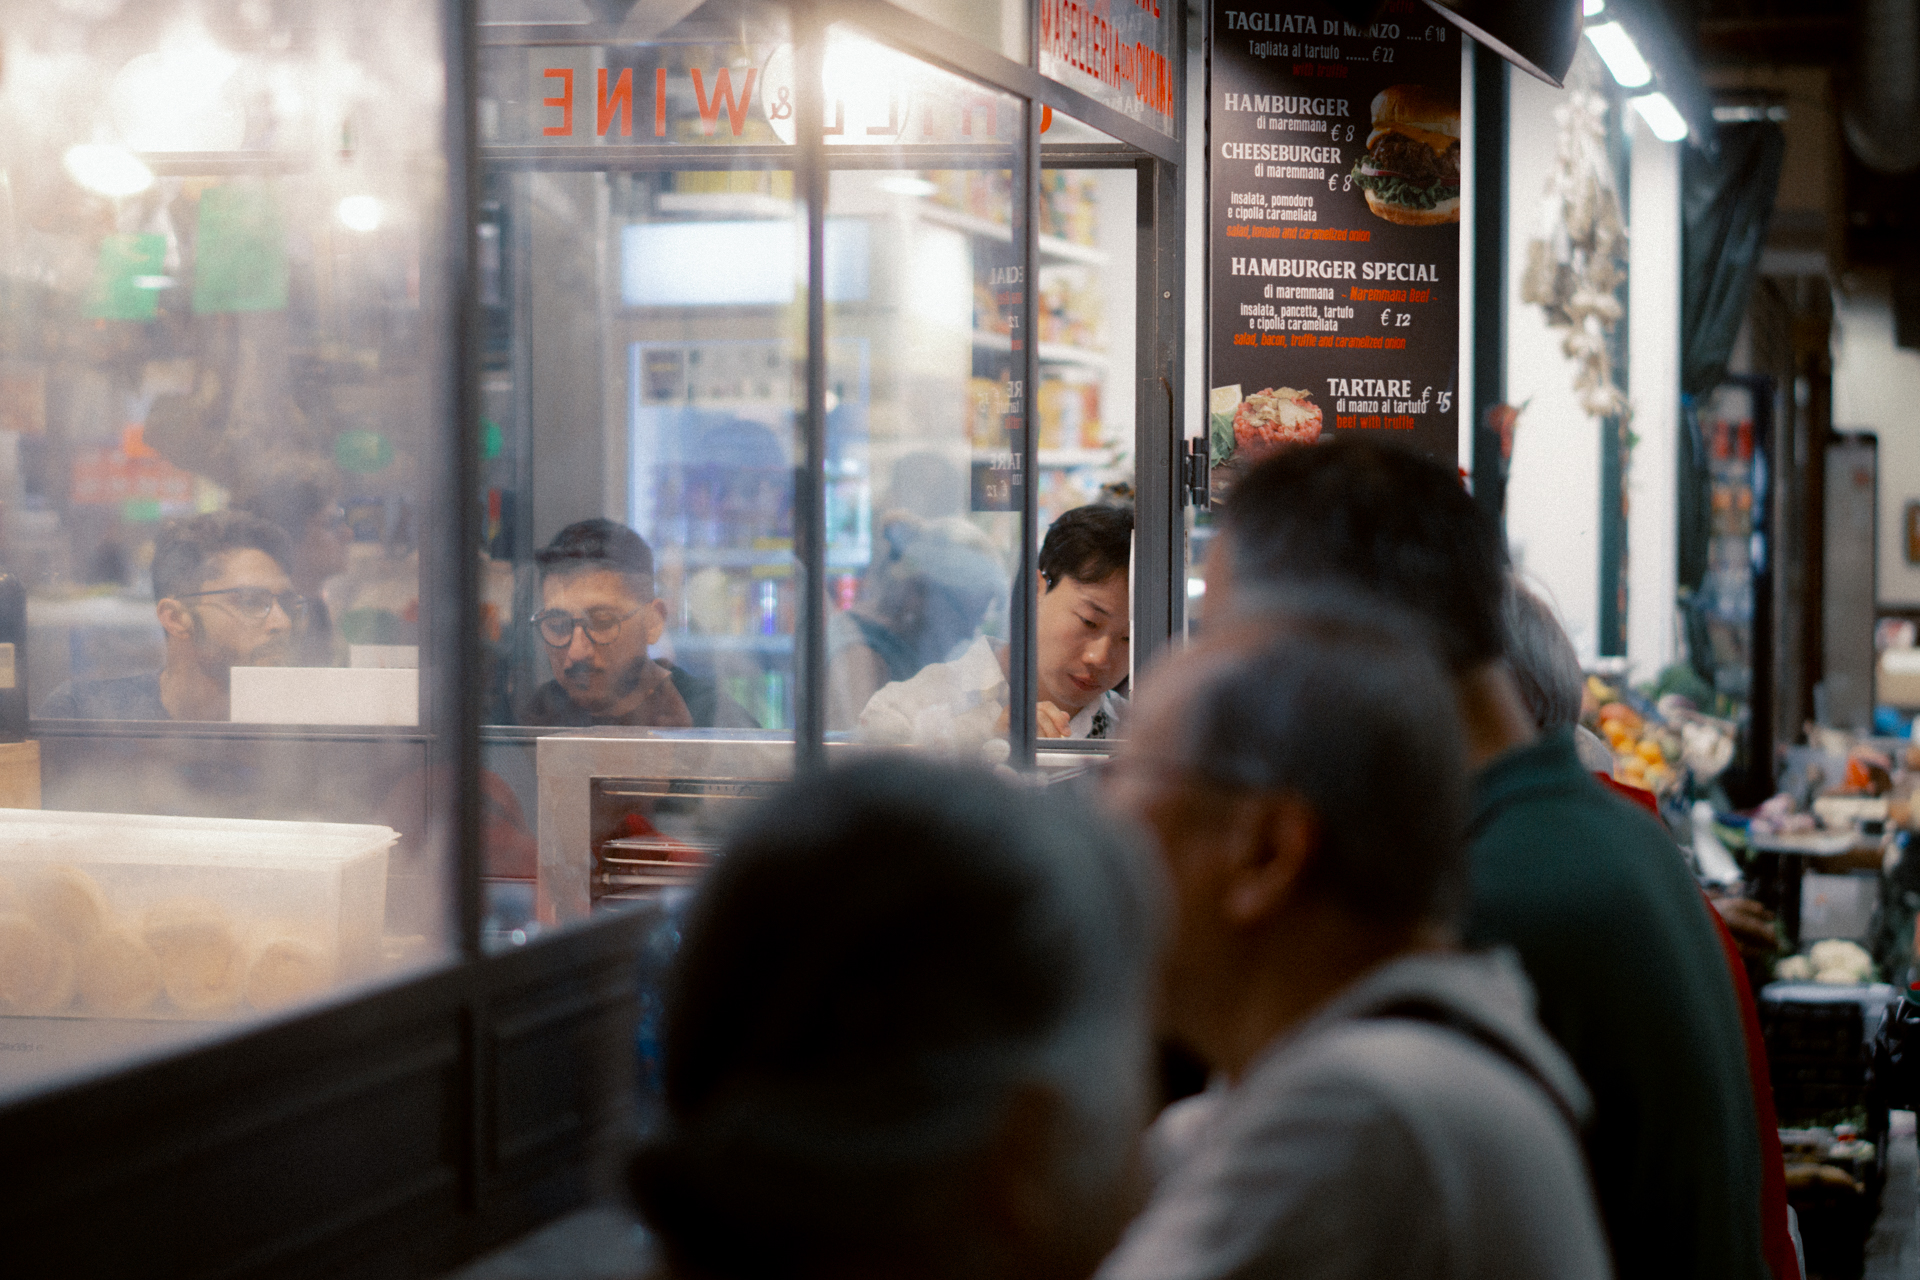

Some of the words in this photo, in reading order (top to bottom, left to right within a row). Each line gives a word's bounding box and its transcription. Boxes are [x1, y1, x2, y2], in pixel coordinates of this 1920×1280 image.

[1225, 11, 1317, 35] TAGLIATA
[1323, 20, 1339, 36] DI
[1343, 22, 1400, 39] MNZO
[1249, 40, 1289, 60] Tagliata
[1292, 41, 1301, 58] al
[1304, 42, 1340, 60] tartufo
[1224, 93, 1350, 117] HAMBURGER
[1256, 115, 1266, 130] di
[1269, 117, 1327, 132] maremmana
[1221, 142, 1341, 164] CHEESEBURGER
[1254, 163, 1264, 177] di
[1266, 165, 1325, 180] maremmana
[1231, 191, 1268, 208] insalata,
[1271, 193, 1313, 208] pomodoro
[1228, 208, 1233, 219] e
[1235, 206, 1264, 221] cipolla
[1266, 208, 1317, 222] caramellata
[1251, 225, 1280, 239] tomato
[1282, 226, 1297, 240] and
[1231, 257, 1357, 280] HAMBURGER
[1362, 261, 1439, 283] SPECIAL
[1264, 284, 1273, 299] di
[1276, 286, 1334, 300] maremmana
[1350, 286, 1407, 302] Maremmana
[1409, 288, 1430, 303] Beef
[1240, 302, 1278, 318] insalata,
[1281, 304, 1321, 320] pancetta,
[1323, 304, 1354, 319] tartufo
[1249, 318, 1255, 329] e
[1257, 316, 1285, 332] cipolla
[1287, 317, 1338, 332] caramellata
[1291, 333, 1317, 348] truffle
[1318, 334, 1333, 348] and
[1335, 335, 1383, 349] caramelized
[1384, 337, 1406, 350] onion
[1327, 378, 1412, 398] TARTARE
[1336, 398, 1346, 413] di
[1349, 400, 1379, 413] manzo
[1381, 399, 1390, 413] al
[1393, 398, 1427, 414] tartufo
[1336, 414, 1357, 429] beef
[1360, 415, 1381, 429] with
[1384, 415, 1415, 430] truffle
